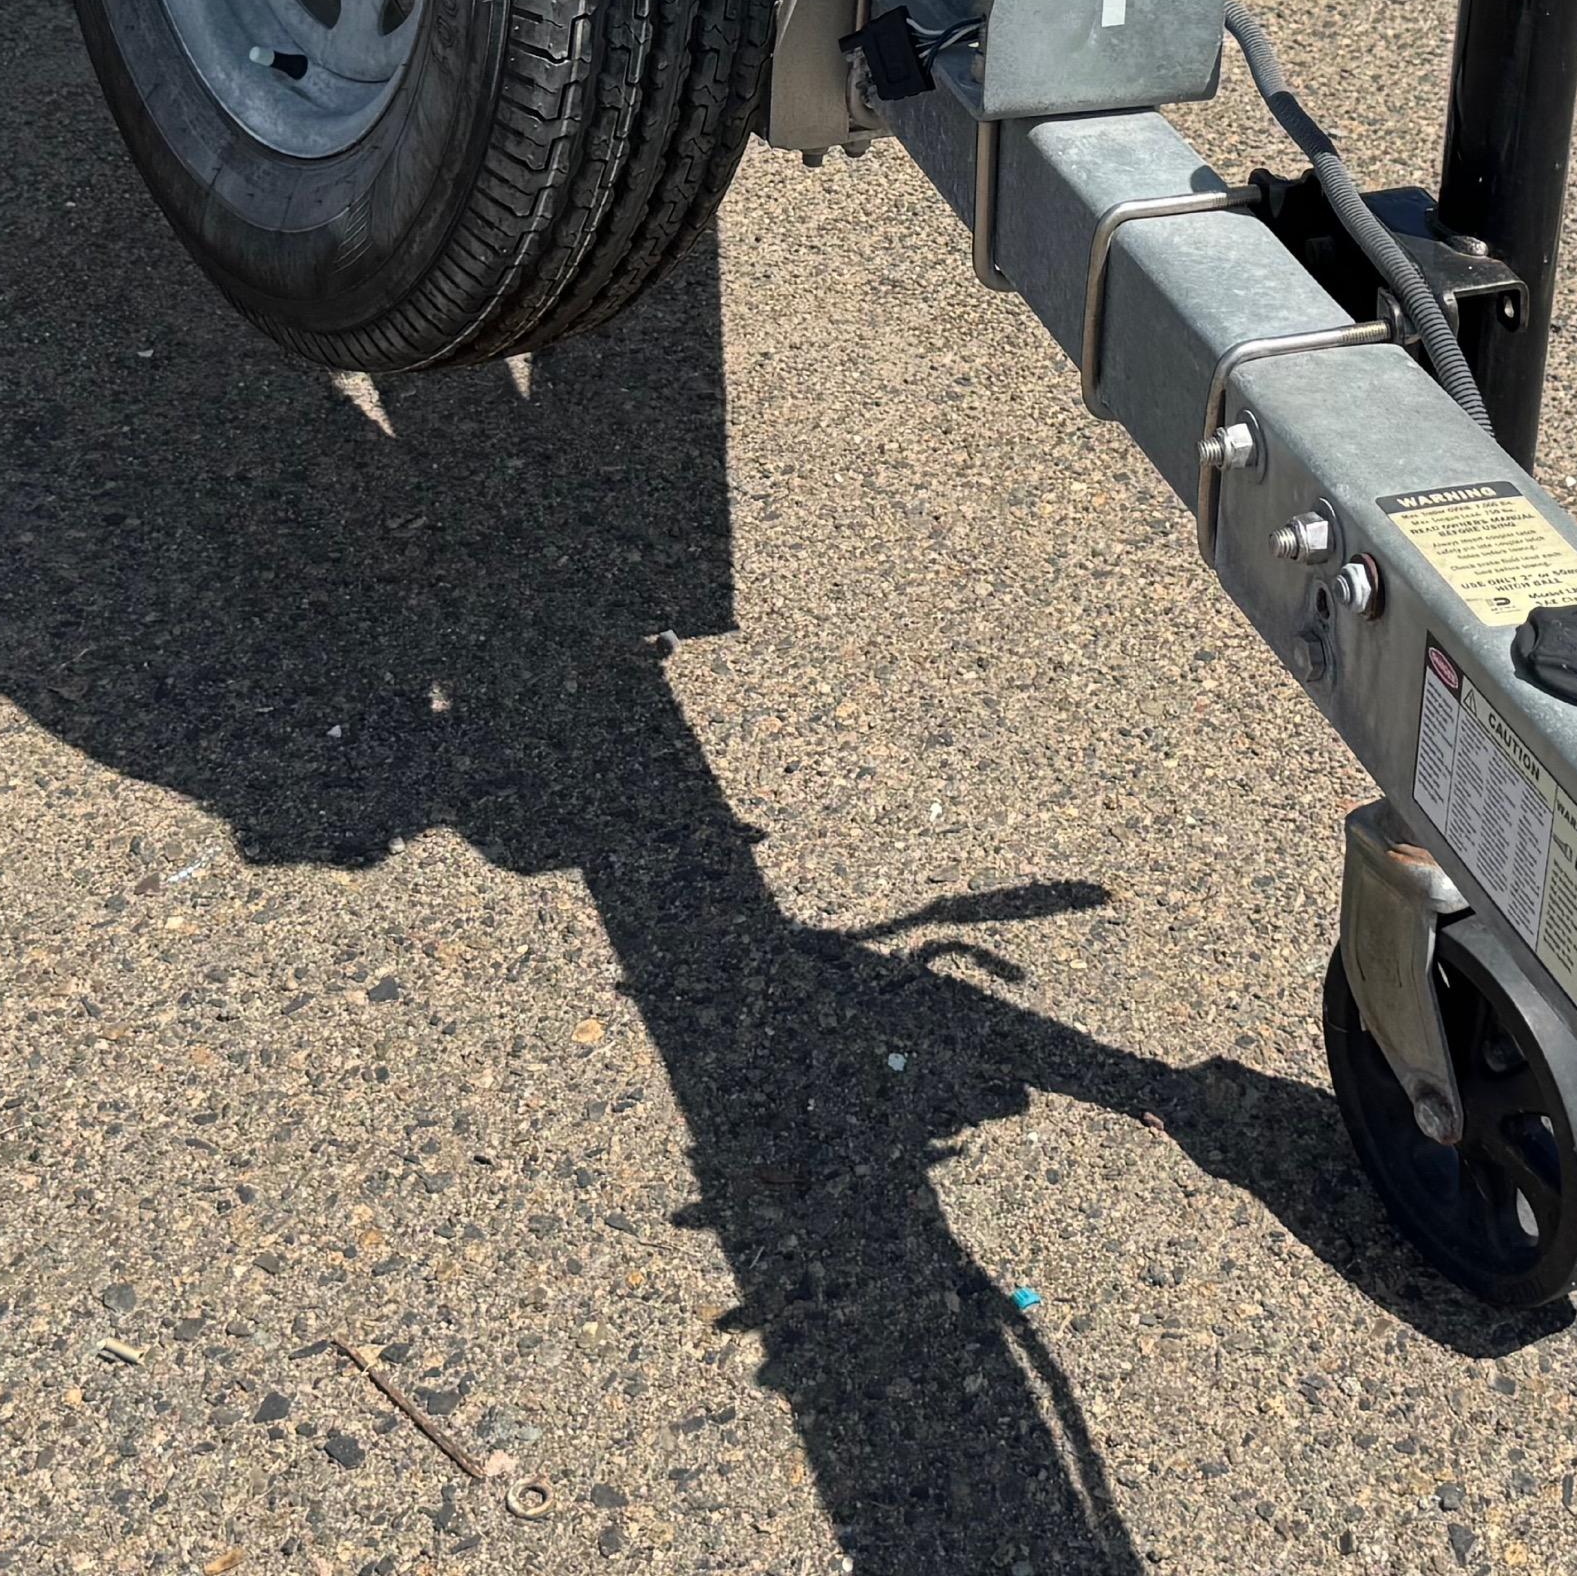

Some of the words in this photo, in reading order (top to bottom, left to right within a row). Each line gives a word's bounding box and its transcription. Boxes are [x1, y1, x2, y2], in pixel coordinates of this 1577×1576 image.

[1397, 487, 1497, 508] WARNING
[1410, 526, 1439, 534] READ
[1490, 514, 1534, 522] MANUAL
[1438, 526, 1480, 537] BEFORE
[1482, 522, 1516, 530] USING
[1461, 581, 1486, 589] USE
[1488, 577, 1516, 585] ONLY
[1495, 582, 1530, 591] HITCH
[1533, 578, 1562, 586] BALL
[1488, 713, 1540, 781] CAUTION
